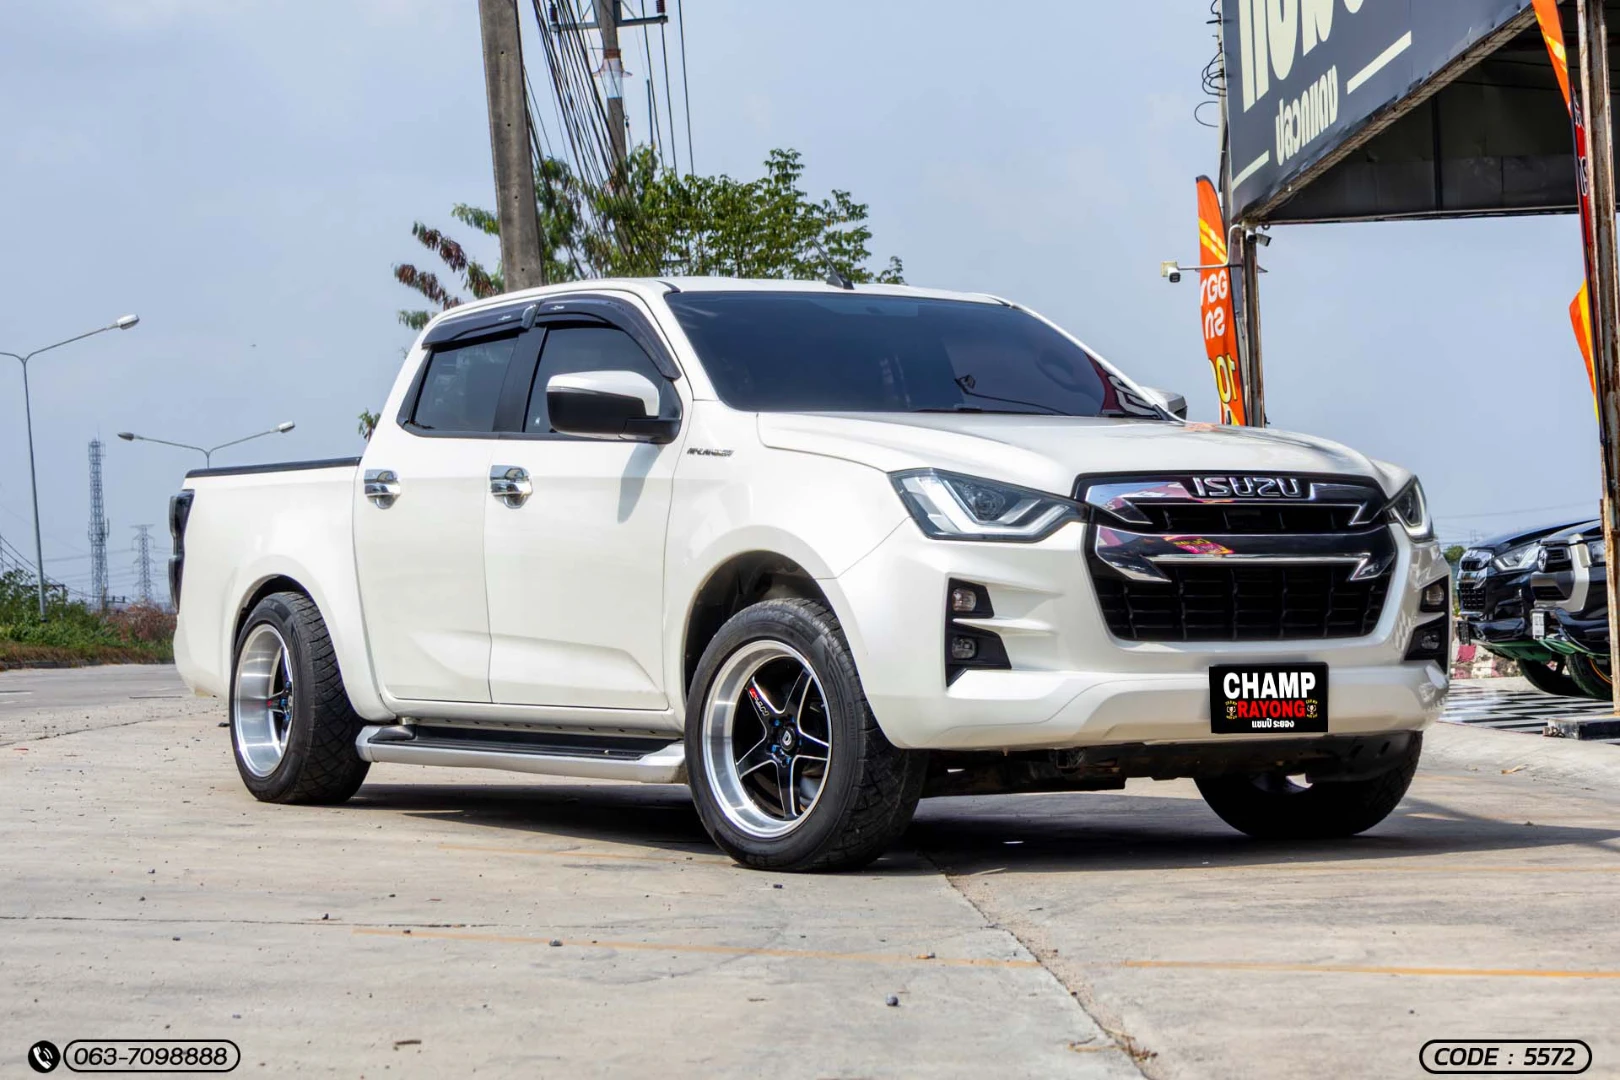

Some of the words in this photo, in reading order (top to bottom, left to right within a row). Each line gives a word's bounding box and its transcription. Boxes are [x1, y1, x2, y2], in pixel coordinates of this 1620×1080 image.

[1275, 64, 1338, 166] ปลวกแดง
[1192, 477, 1302, 497] ISUZU
[1223, 672, 1316, 699] CHAMP
[1237, 701, 1306, 718] RAYONG
